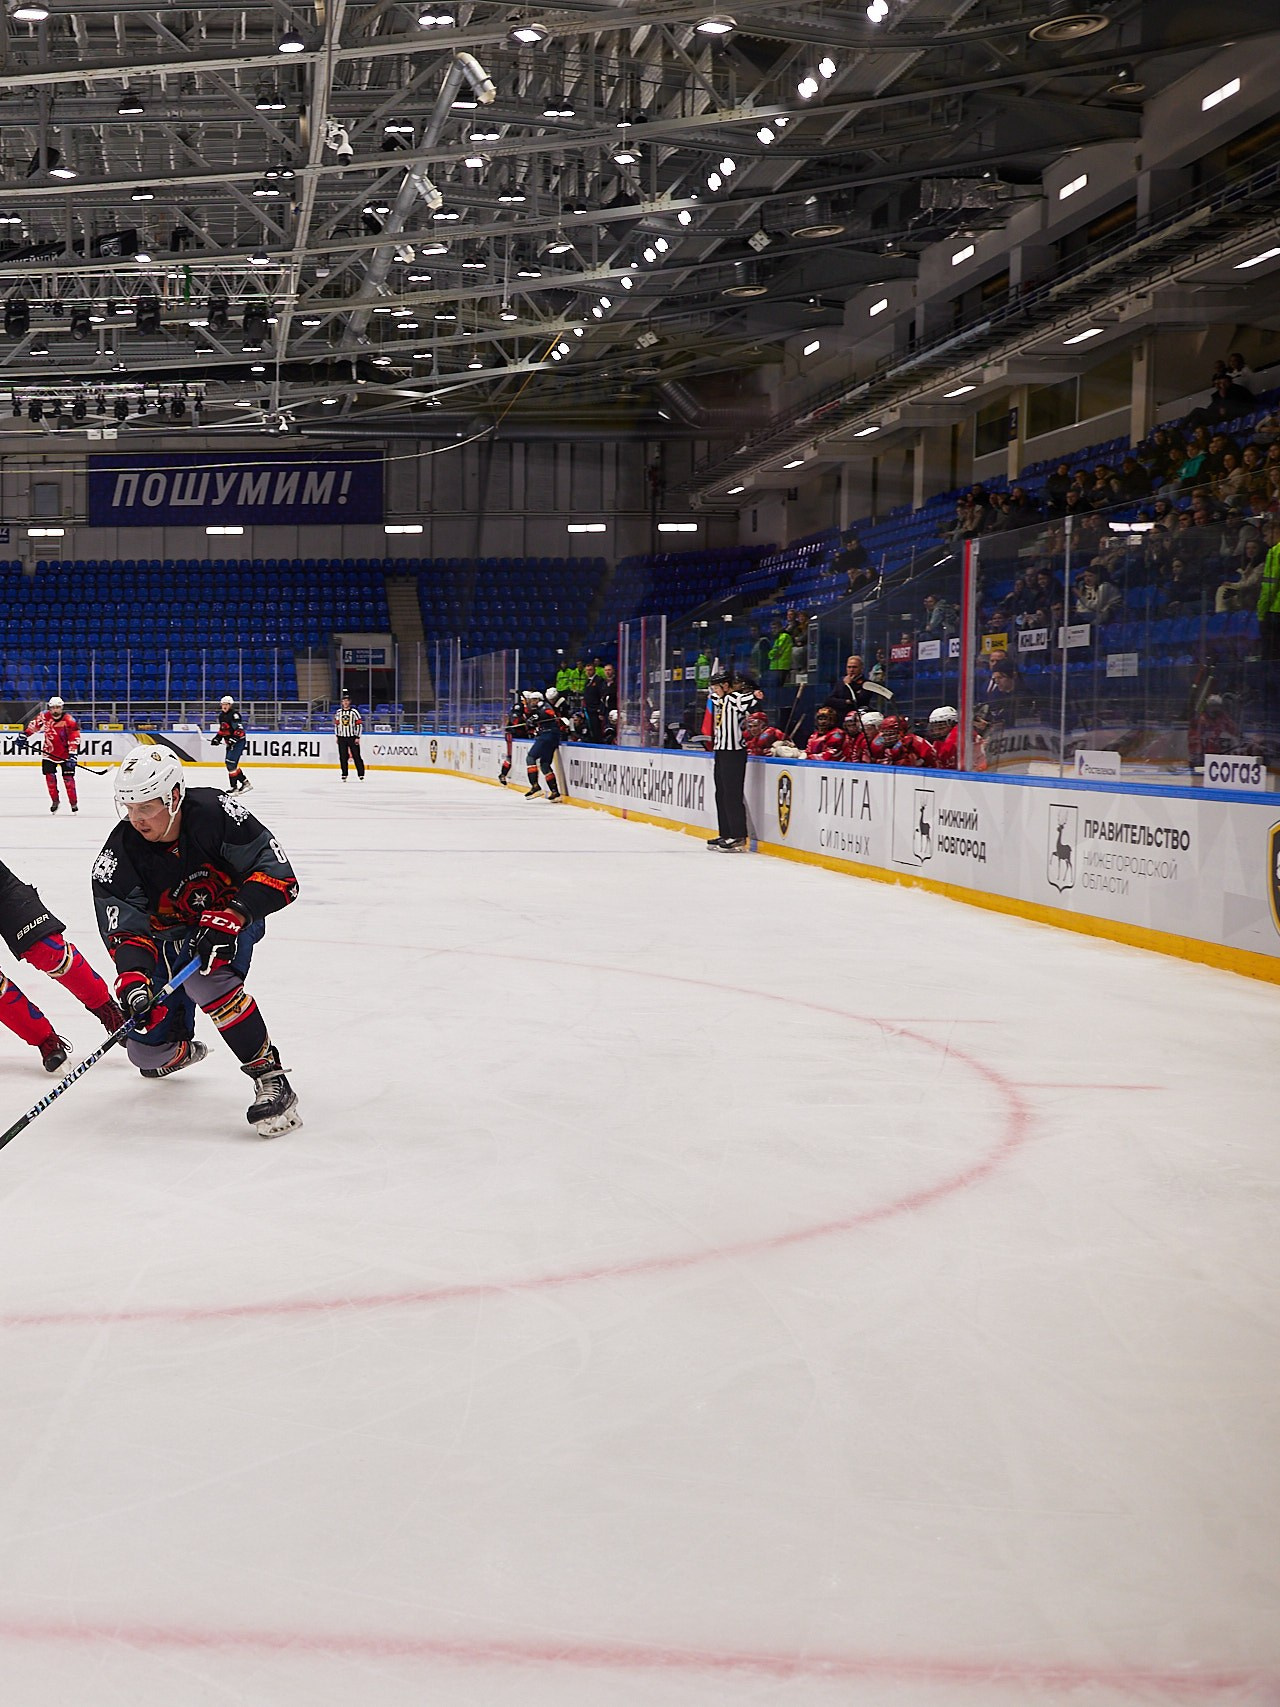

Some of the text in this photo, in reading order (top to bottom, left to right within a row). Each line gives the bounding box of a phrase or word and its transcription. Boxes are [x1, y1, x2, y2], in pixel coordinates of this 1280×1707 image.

[112, 470, 353, 507] ПОШУМИМ!
[78, 740, 113, 756] ИГА
[245, 740, 321, 757] HLIGA.RU
[570, 758, 705, 811] ОФИЦЕРСКАЯ ХОККЕЙНАЯ ЛИГА
[818, 776, 872, 821] ЛИГА
[938, 807, 979, 831] НИЖНИЙ
[820, 828, 870, 856] СИЛЬНЫХ
[938, 834, 987, 863] НОВГОРОД
[1084, 819, 1190, 851] ПРАВИТЕЛЬСТВО
[1083, 851, 1178, 880] НИЖЕГОРОДСКОЙ
[1082, 872, 1129, 895] ОБЛАСТИ
[16, 913, 50, 940] BAUER
[200, 914, 242, 932] CCM
[26, 1047, 105, 1122] SHERWOOD
